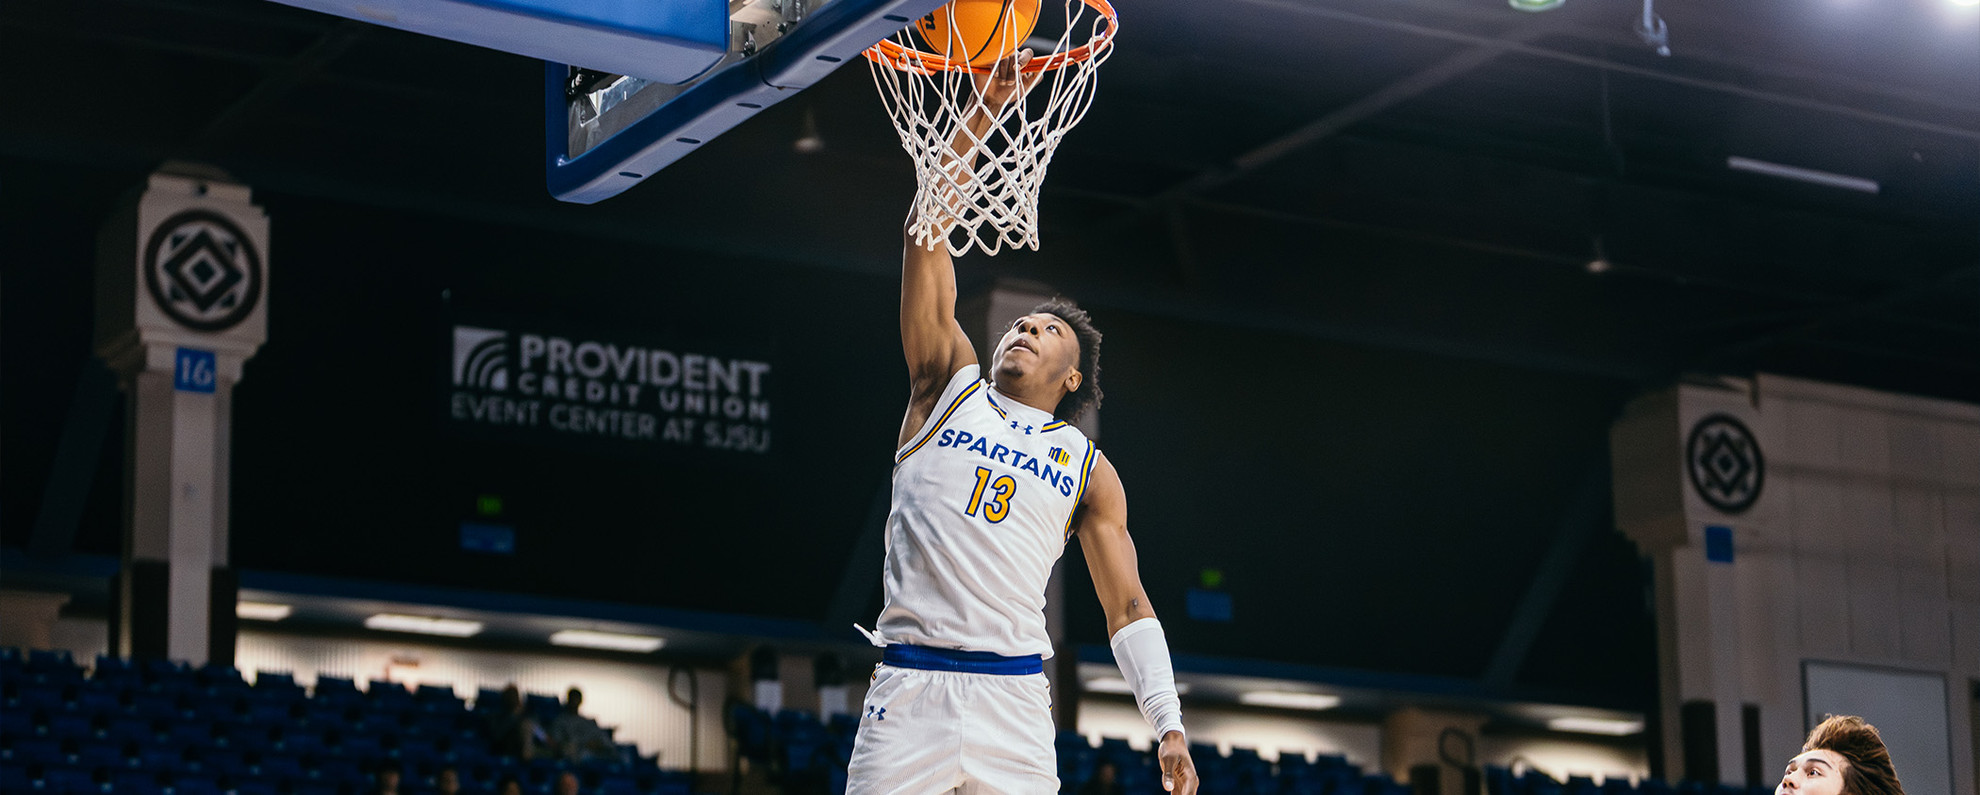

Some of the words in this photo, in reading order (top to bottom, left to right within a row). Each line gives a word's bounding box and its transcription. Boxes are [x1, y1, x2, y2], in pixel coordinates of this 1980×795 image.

[182, 357, 212, 385] 16
[520, 334, 770, 395] PROVIDENT
[451, 393, 540, 425] EVENT
[549, 404, 655, 438] CENTER
[662, 417, 695, 442] AT
[703, 422, 769, 451] SJSU
[518, 372, 640, 406] CREDIT
[660, 389, 769, 421] UNION
[938, 429, 1074, 498] SPARTANS
[965, 465, 1017, 524] 13
